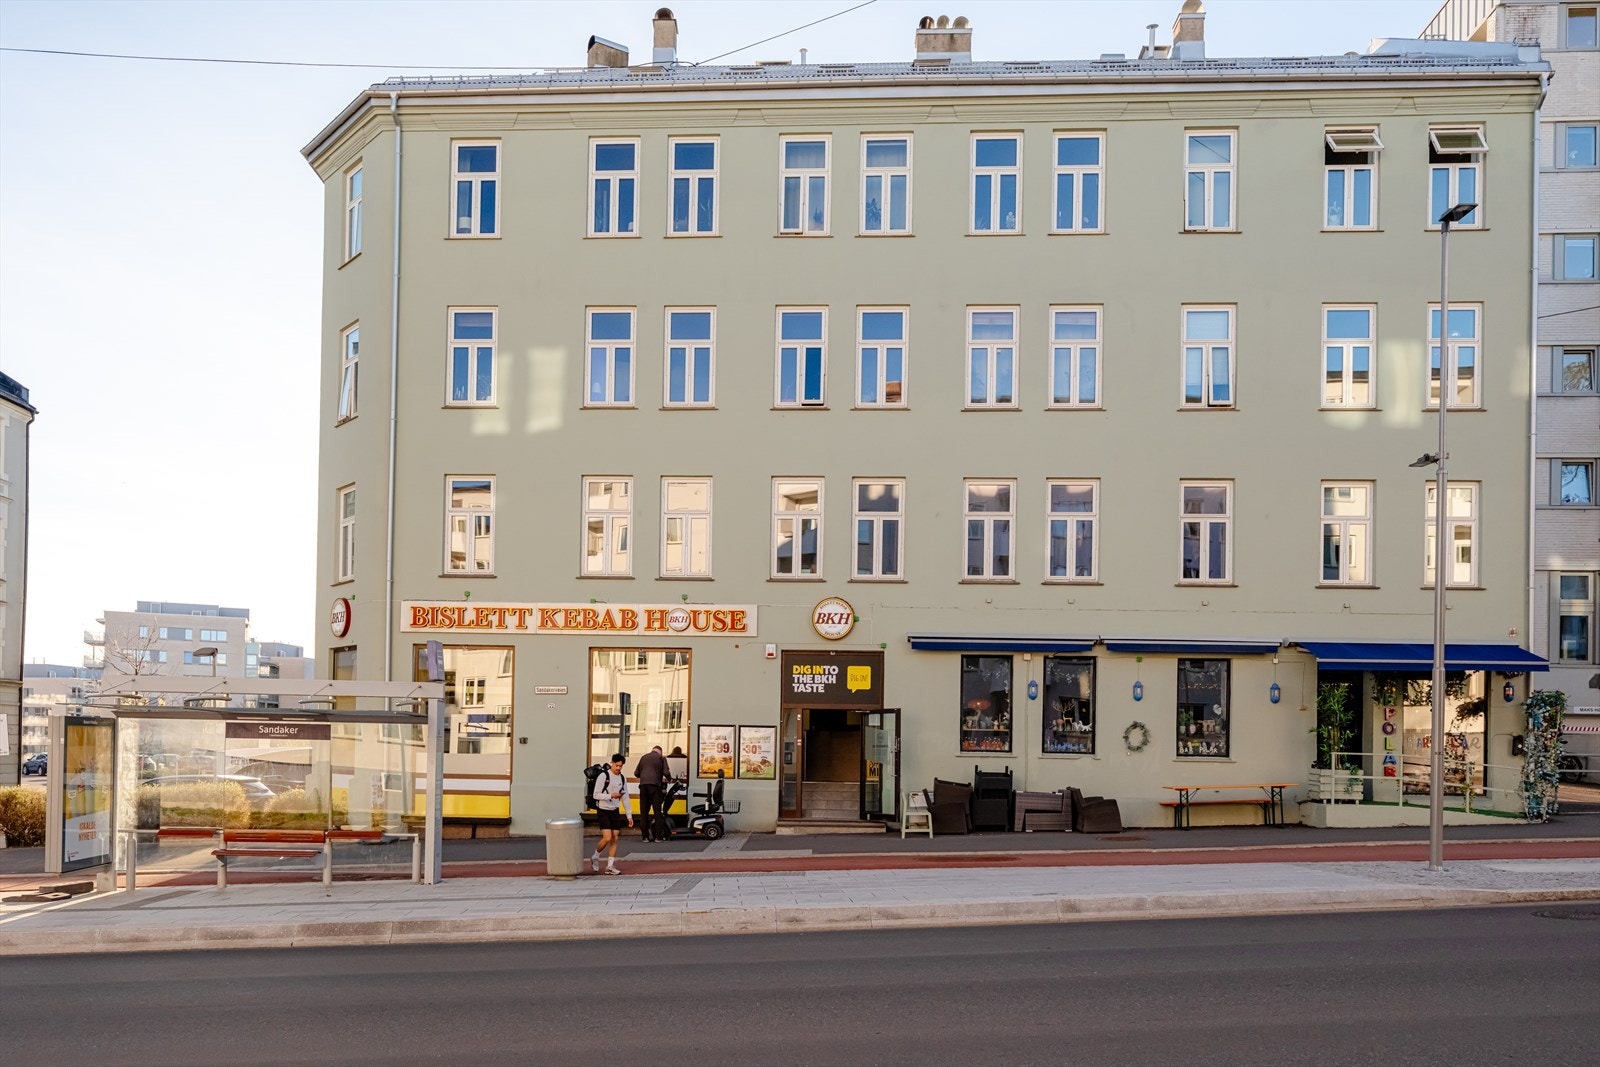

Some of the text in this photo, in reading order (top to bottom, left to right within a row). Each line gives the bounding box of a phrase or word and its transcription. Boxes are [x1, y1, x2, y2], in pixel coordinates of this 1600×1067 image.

[331, 611, 346, 624] BKH
[410, 606, 532, 629] BISLETT
[537, 607, 638, 631] KEBAB
[815, 612, 852, 625] BKH
[792, 665, 839, 675] DIG INTO
[792, 674, 836, 684] THE BKH
[792, 684, 825, 693] TASTE
[258, 725, 299, 734] Sandaker
[1383, 706, 1397, 778] POLAR
